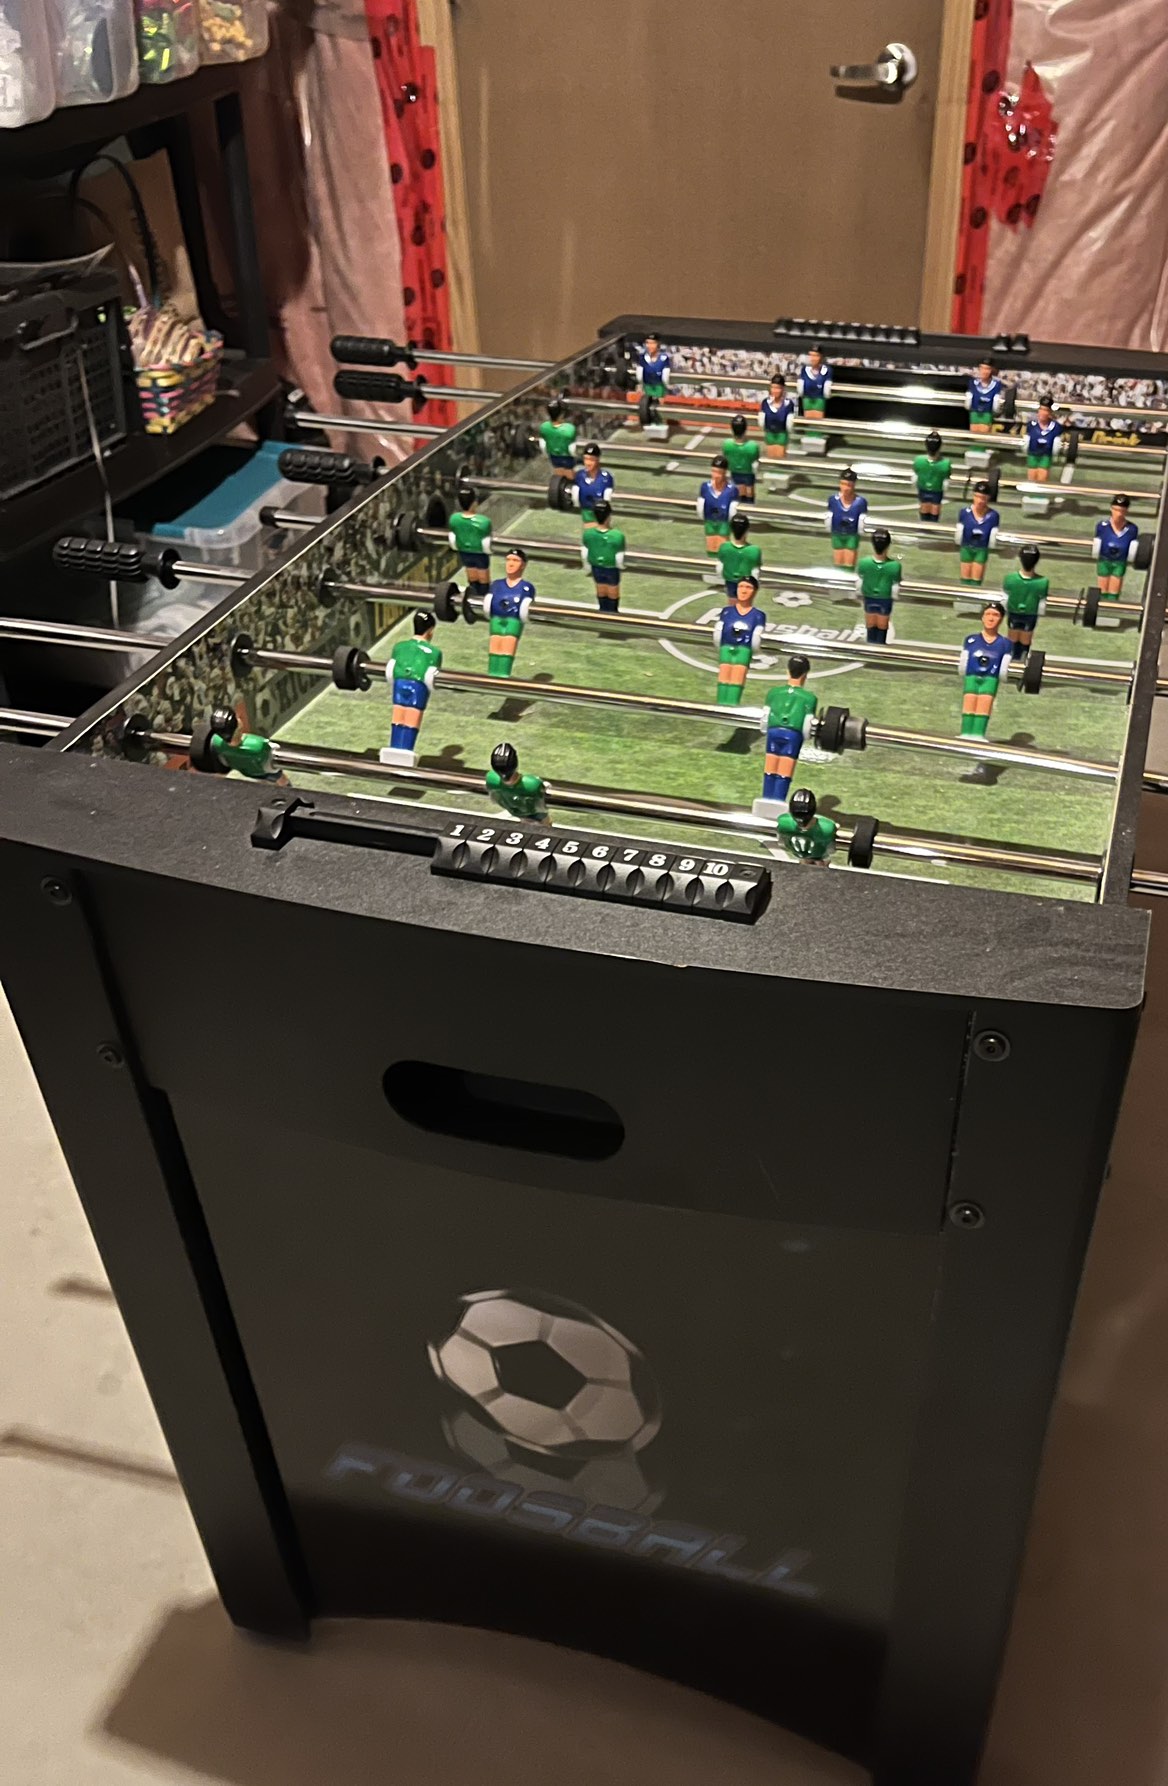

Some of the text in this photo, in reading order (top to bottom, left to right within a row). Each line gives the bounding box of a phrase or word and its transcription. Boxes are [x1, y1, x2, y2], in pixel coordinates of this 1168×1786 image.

[450, 824, 729, 876] 1 2 3 4 5 6 7 8 9 10
[324, 1440, 820, 1599] FOOSBALL
